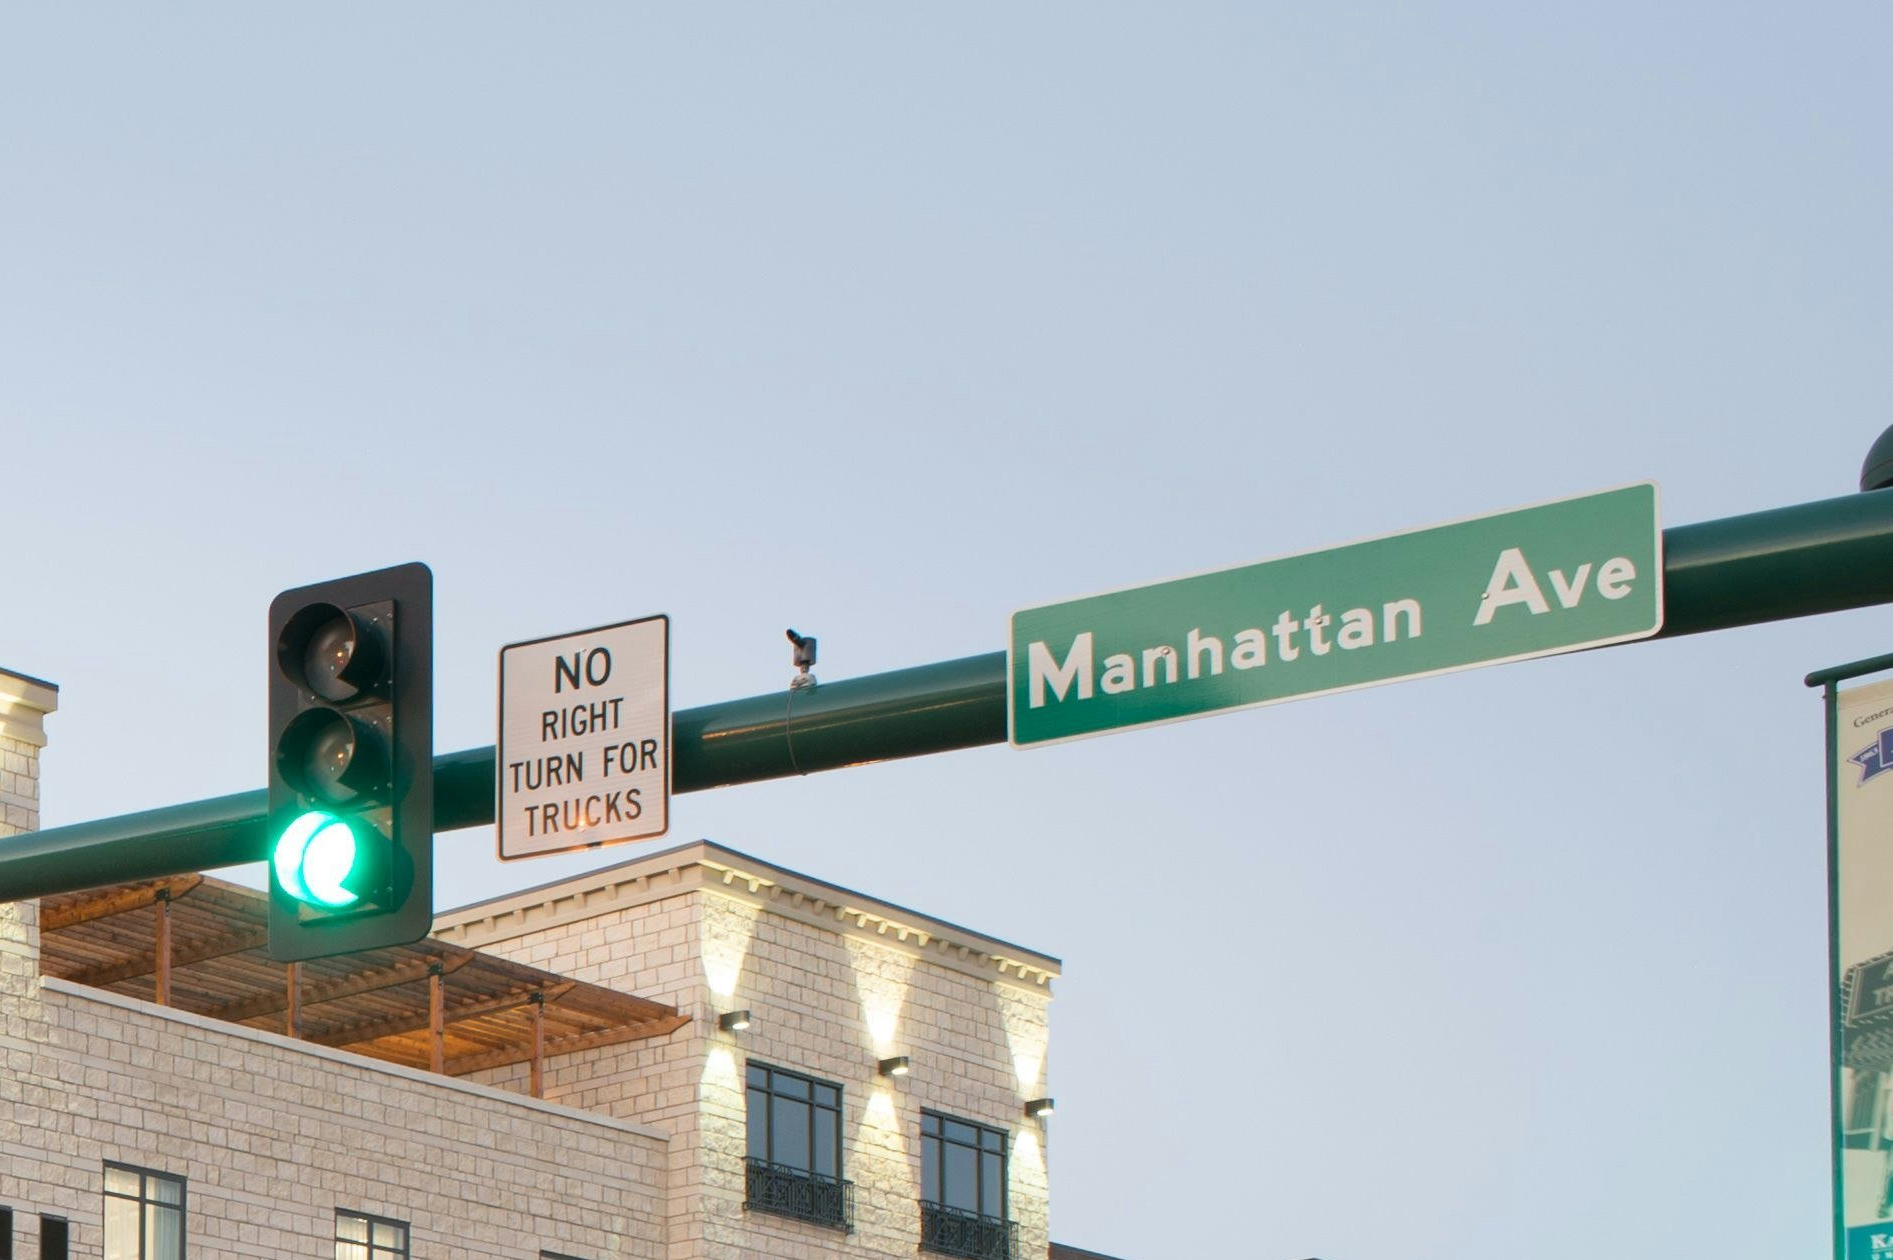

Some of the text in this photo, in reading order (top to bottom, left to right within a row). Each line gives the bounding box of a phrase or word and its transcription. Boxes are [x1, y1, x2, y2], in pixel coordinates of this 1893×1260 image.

[1028, 547, 1636, 709] Manhattan Ave
[554, 647, 611, 694] NO
[541, 697, 624, 743] RIGHT
[509, 739, 658, 793] TURN FOR
[524, 788, 642, 837] TRUCKS
